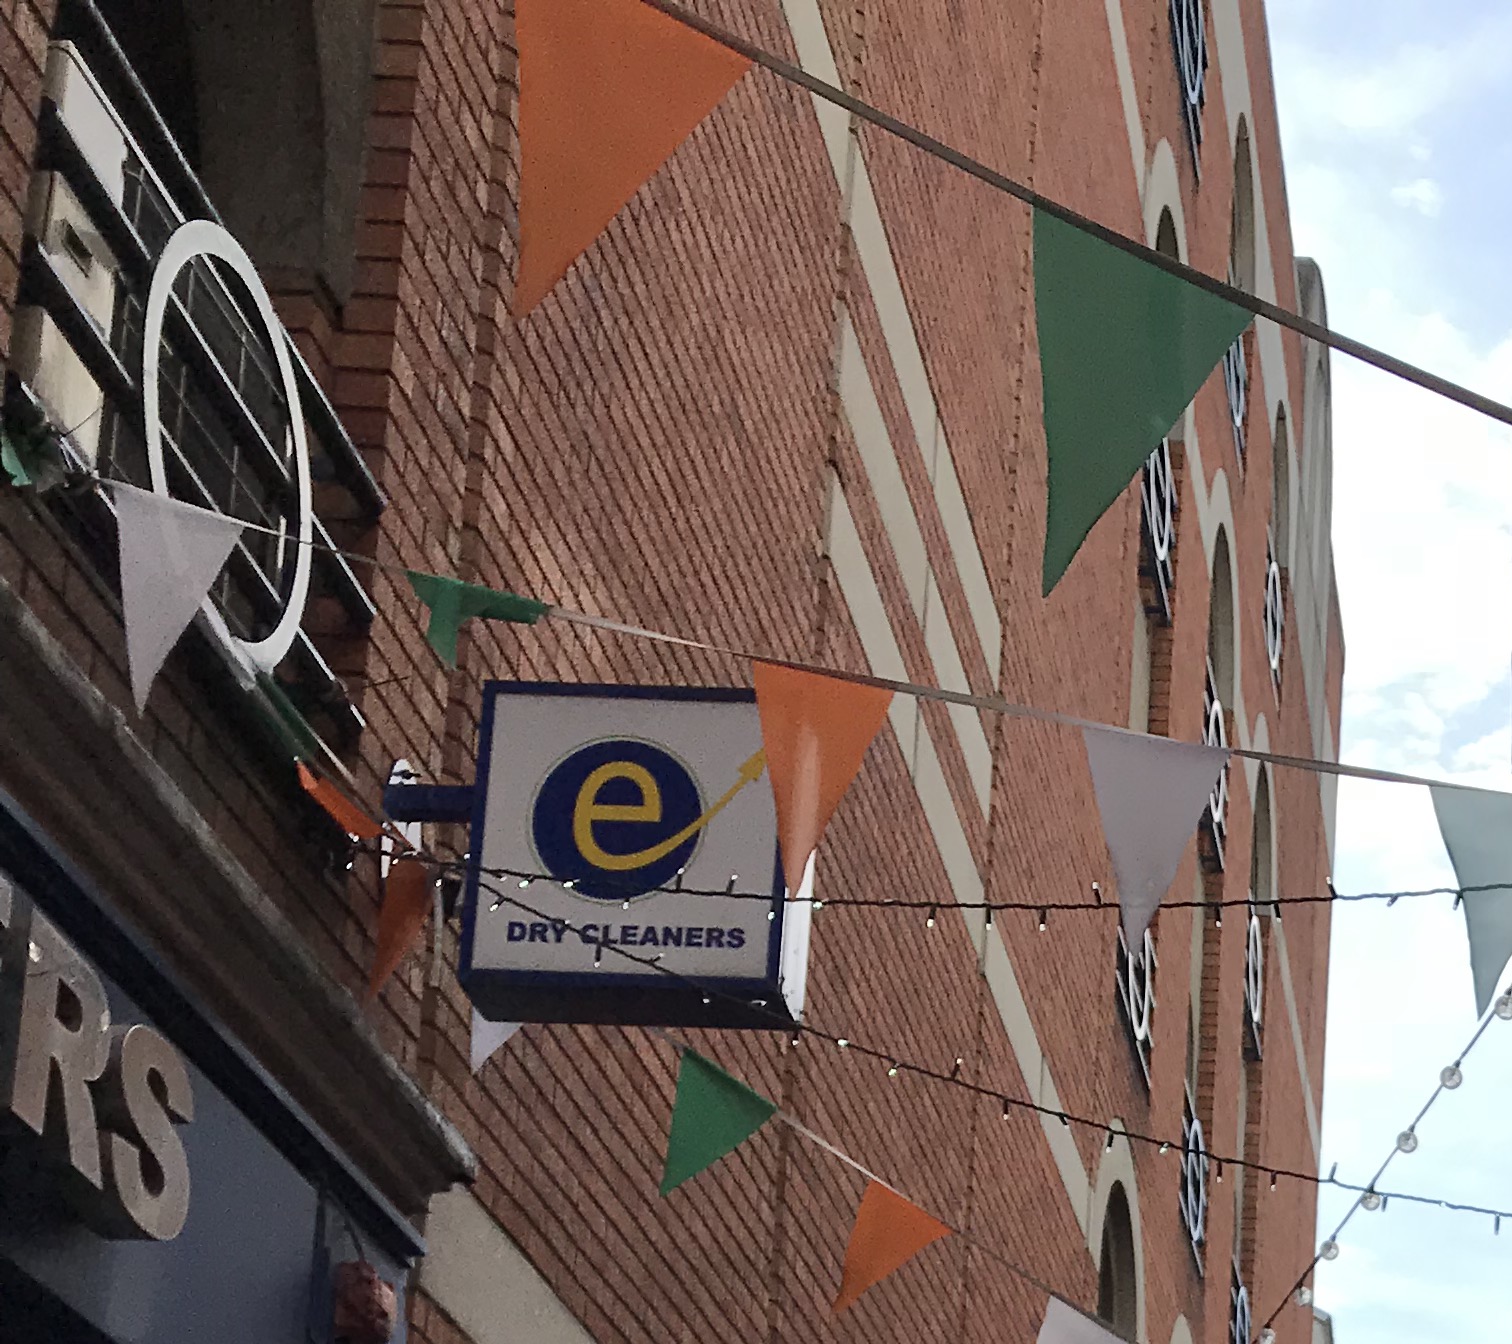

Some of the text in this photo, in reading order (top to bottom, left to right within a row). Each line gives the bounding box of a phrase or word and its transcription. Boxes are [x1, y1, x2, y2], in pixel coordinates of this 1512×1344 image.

[506, 920, 746, 948] DRY CLEANERS
[0, 874, 194, 1241] RS
